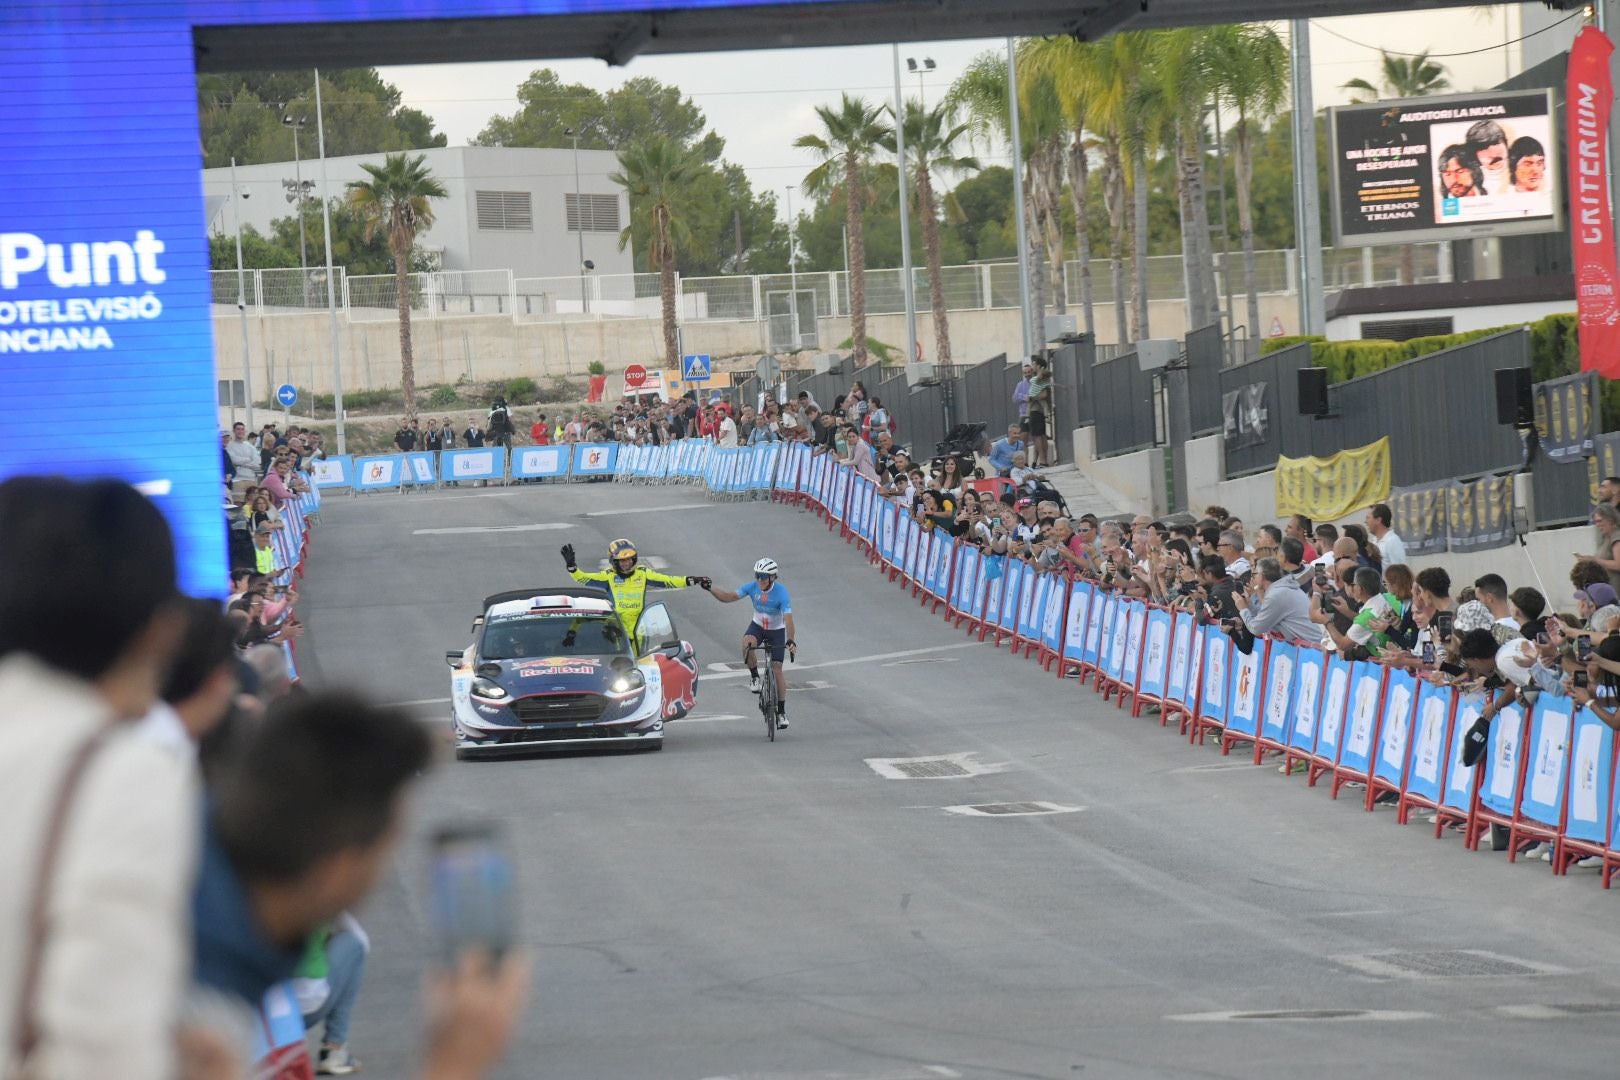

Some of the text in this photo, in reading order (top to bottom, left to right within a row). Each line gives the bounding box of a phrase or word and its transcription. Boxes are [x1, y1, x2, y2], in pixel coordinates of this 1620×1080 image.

[1399, 109, 1453, 123] AUDITORI
[1453, 108, 1468, 118] LA
[1390, 146, 1403, 156] DE
[1578, 83, 1602, 244] CRITERIUM
[1360, 201, 1420, 213] ETERNOS
[1365, 210, 1416, 221] TRIANA
[0, 230, 167, 290] Punt
[626, 372, 645, 380] STOP
[520, 665, 594, 678] Red Bull
